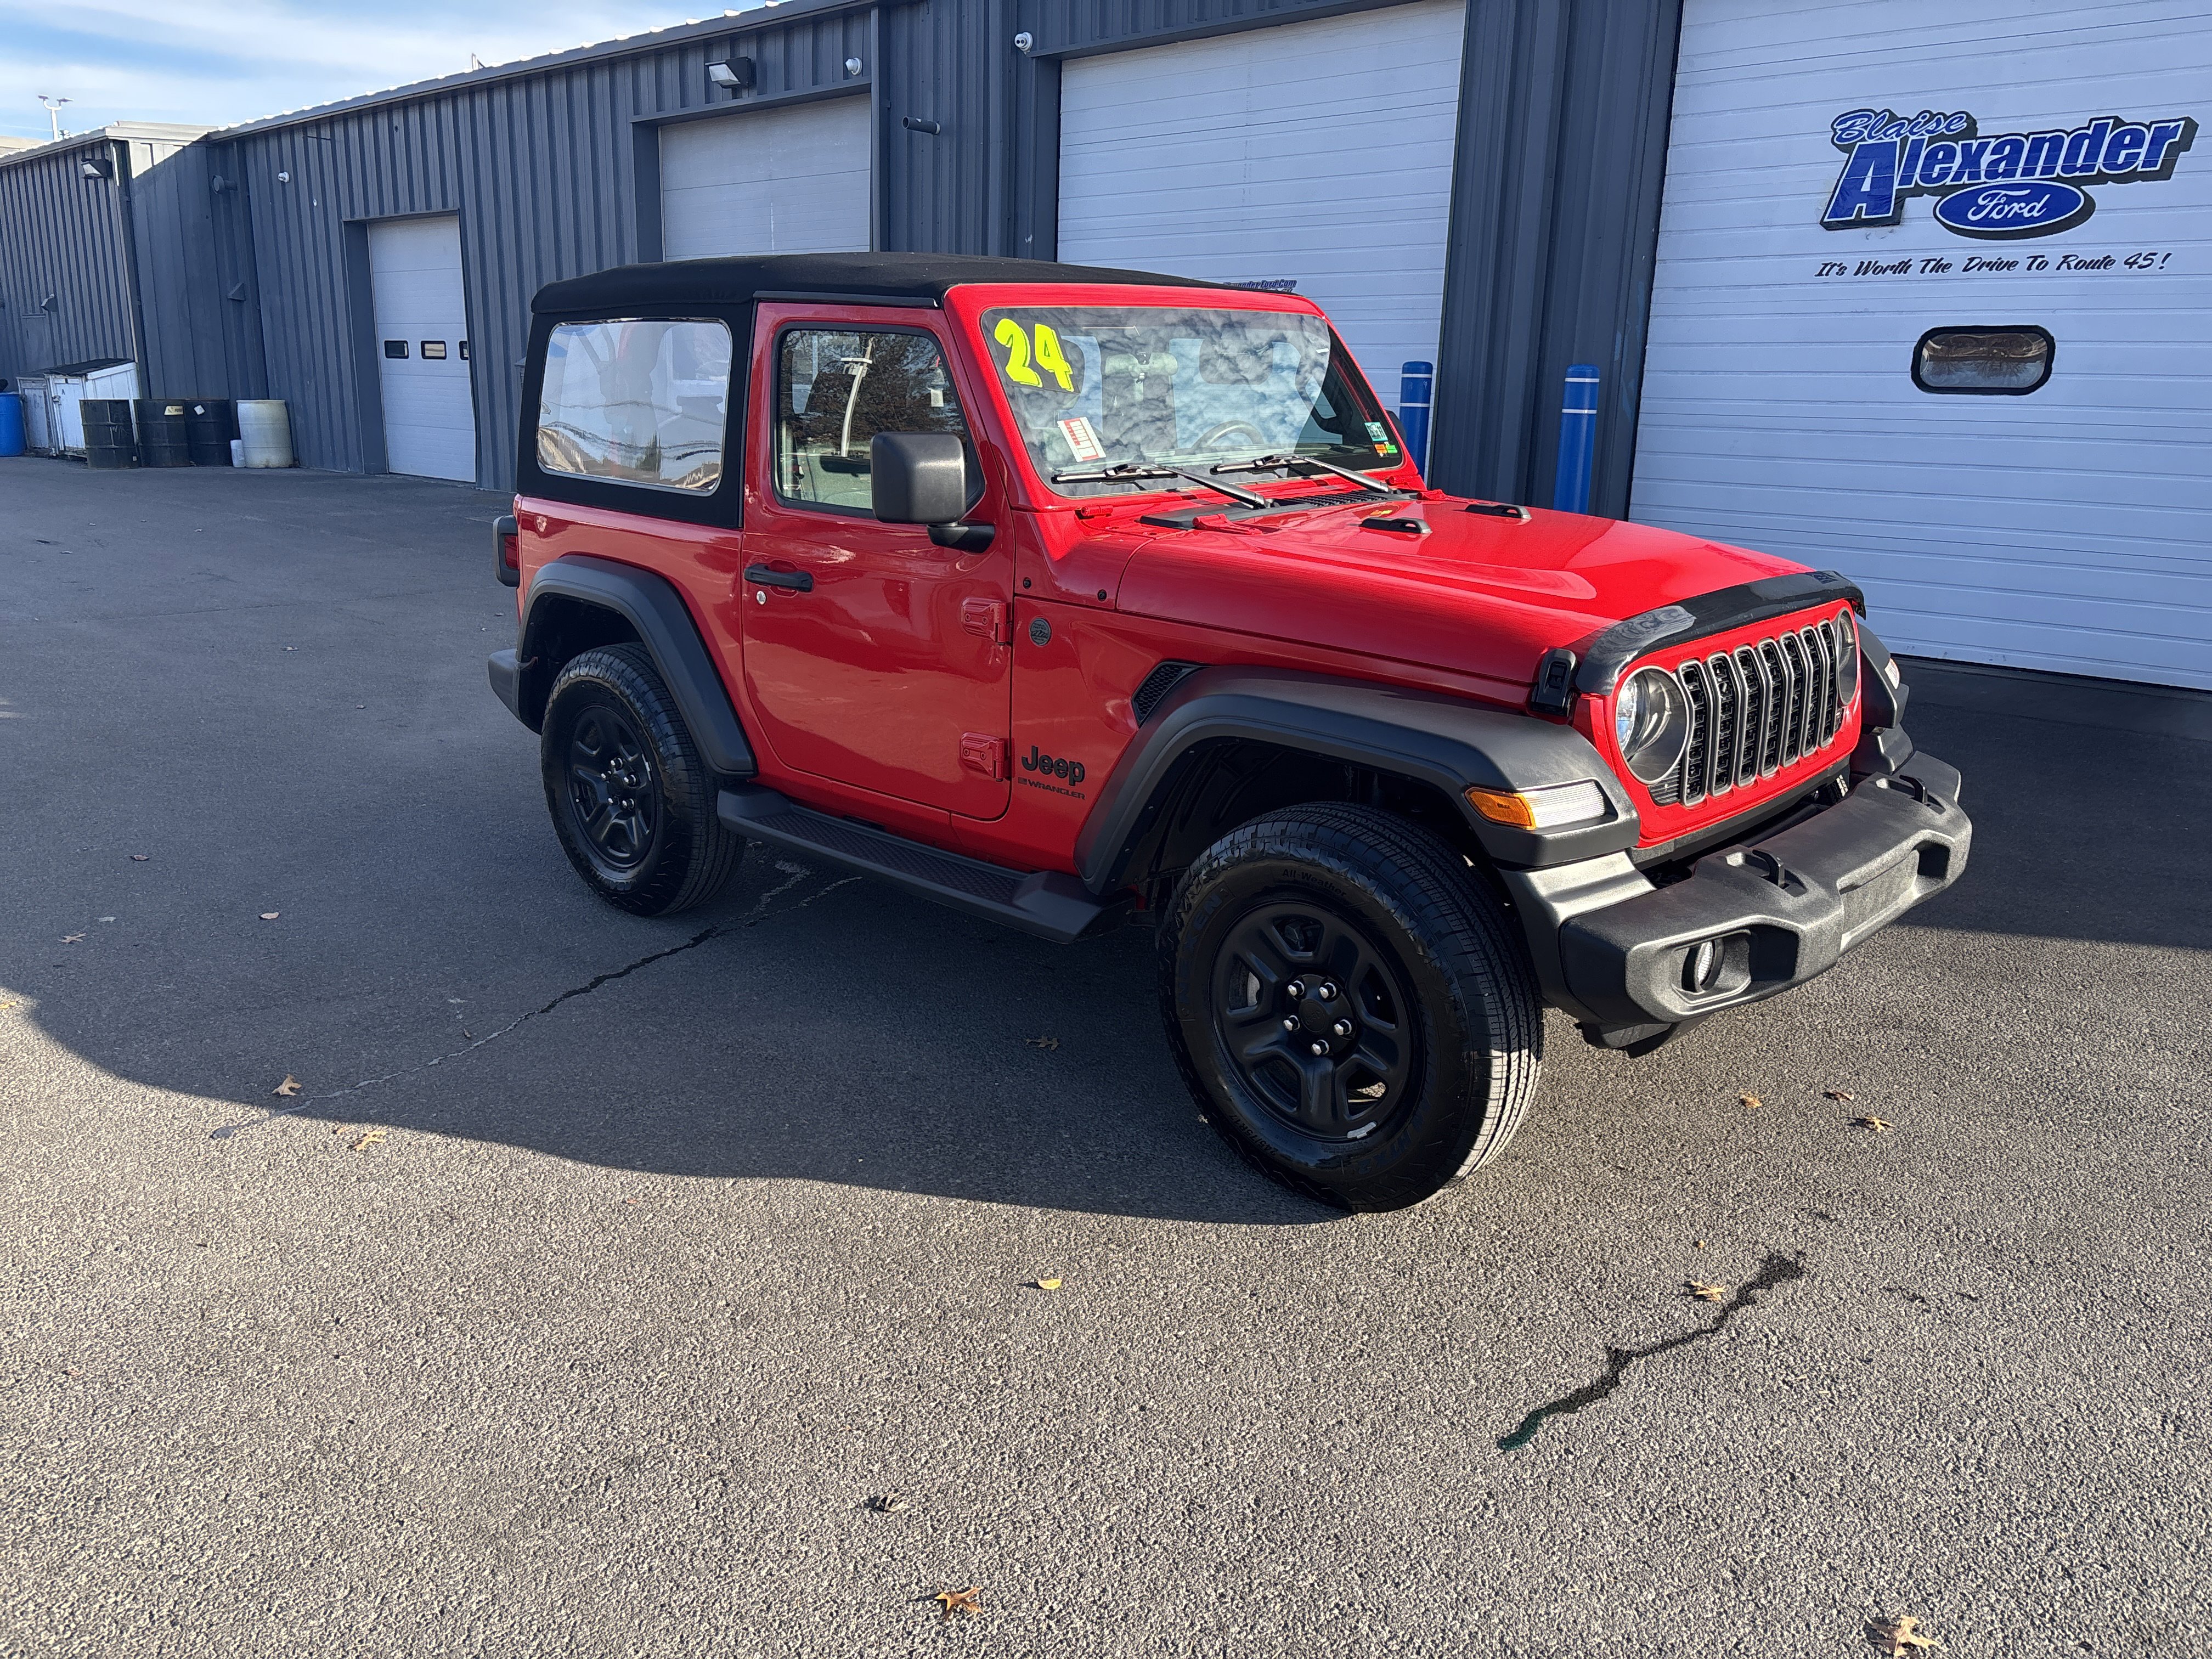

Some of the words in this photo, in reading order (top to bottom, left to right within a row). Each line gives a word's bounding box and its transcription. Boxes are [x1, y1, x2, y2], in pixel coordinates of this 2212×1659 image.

[1833, 111, 1967, 145] Blaise
[1823, 119, 2185, 222] Alexander
[1967, 189, 2051, 221] Ford
[1814, 261, 1848, 277] It's
[1853, 258, 1913, 276] Worth
[1919, 257, 1953, 274] The
[1961, 256, 2019, 273] Drive
[2026, 255, 2049, 271] To
[2056, 254, 2117, 270] Route
[994, 318, 1074, 392] 24
[1021, 745, 1085, 787] Jeep
[1028, 779, 1085, 799] WRANGLER
[1282, 868, 1347, 896] All-Weather
[1228, 1114, 1278, 1156] 245/75R17
